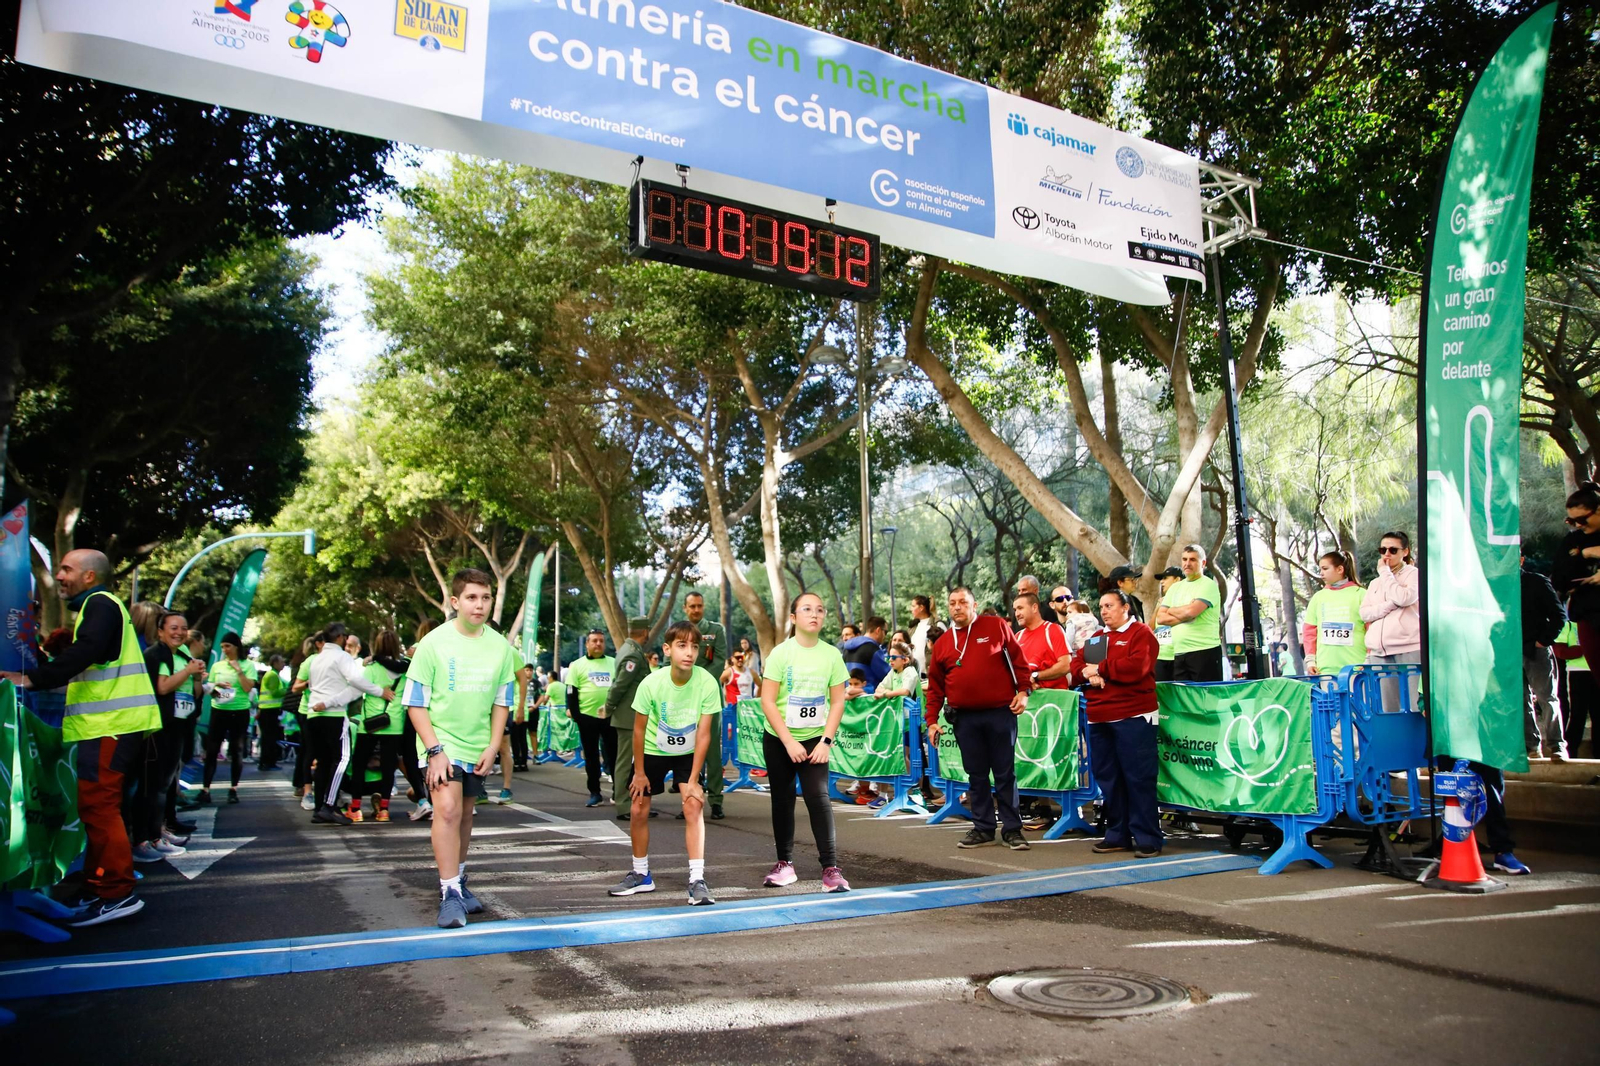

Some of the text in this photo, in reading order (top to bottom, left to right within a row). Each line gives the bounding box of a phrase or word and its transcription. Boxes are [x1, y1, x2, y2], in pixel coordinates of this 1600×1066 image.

[191, 17, 270, 43] Almería 2005
[403, 14, 458, 38] DE CABRAS
[530, 0, 966, 124] mería en marcha
[528, 30, 920, 156] contra el cáncer
[510, 97, 686, 148] #TodosContraElCáncer
[1033, 126, 1096, 156] cajamar
[1143, 158, 1192, 181] UNIVERSIDAD
[1145, 167, 1156, 177] DE
[904, 178, 985, 206] asociación española
[906, 189, 970, 212] contra el cáncer
[1039, 181, 1172, 218] MICHELIN Fundación
[906, 201, 952, 218] en Almería
[1044, 212, 1076, 230] Toyota
[1045, 226, 1112, 251] Alborán Motor
[1140, 226, 1198, 249] Ejido Motor
[1160, 253, 1176, 263] Jeep
[1446, 259, 1508, 283] Tenmos
[1445, 287, 1495, 310] un gran
[1444, 312, 1491, 332] camino
[1442, 340, 1464, 360] por
[1441, 360, 1492, 380] delante
[1324, 630, 1350, 638] 1163
[800, 707, 817, 718] 88
[667, 736, 686, 746] 89
[1175, 736, 1218, 751] cáncer
[1162, 750, 1213, 768] solo uno
